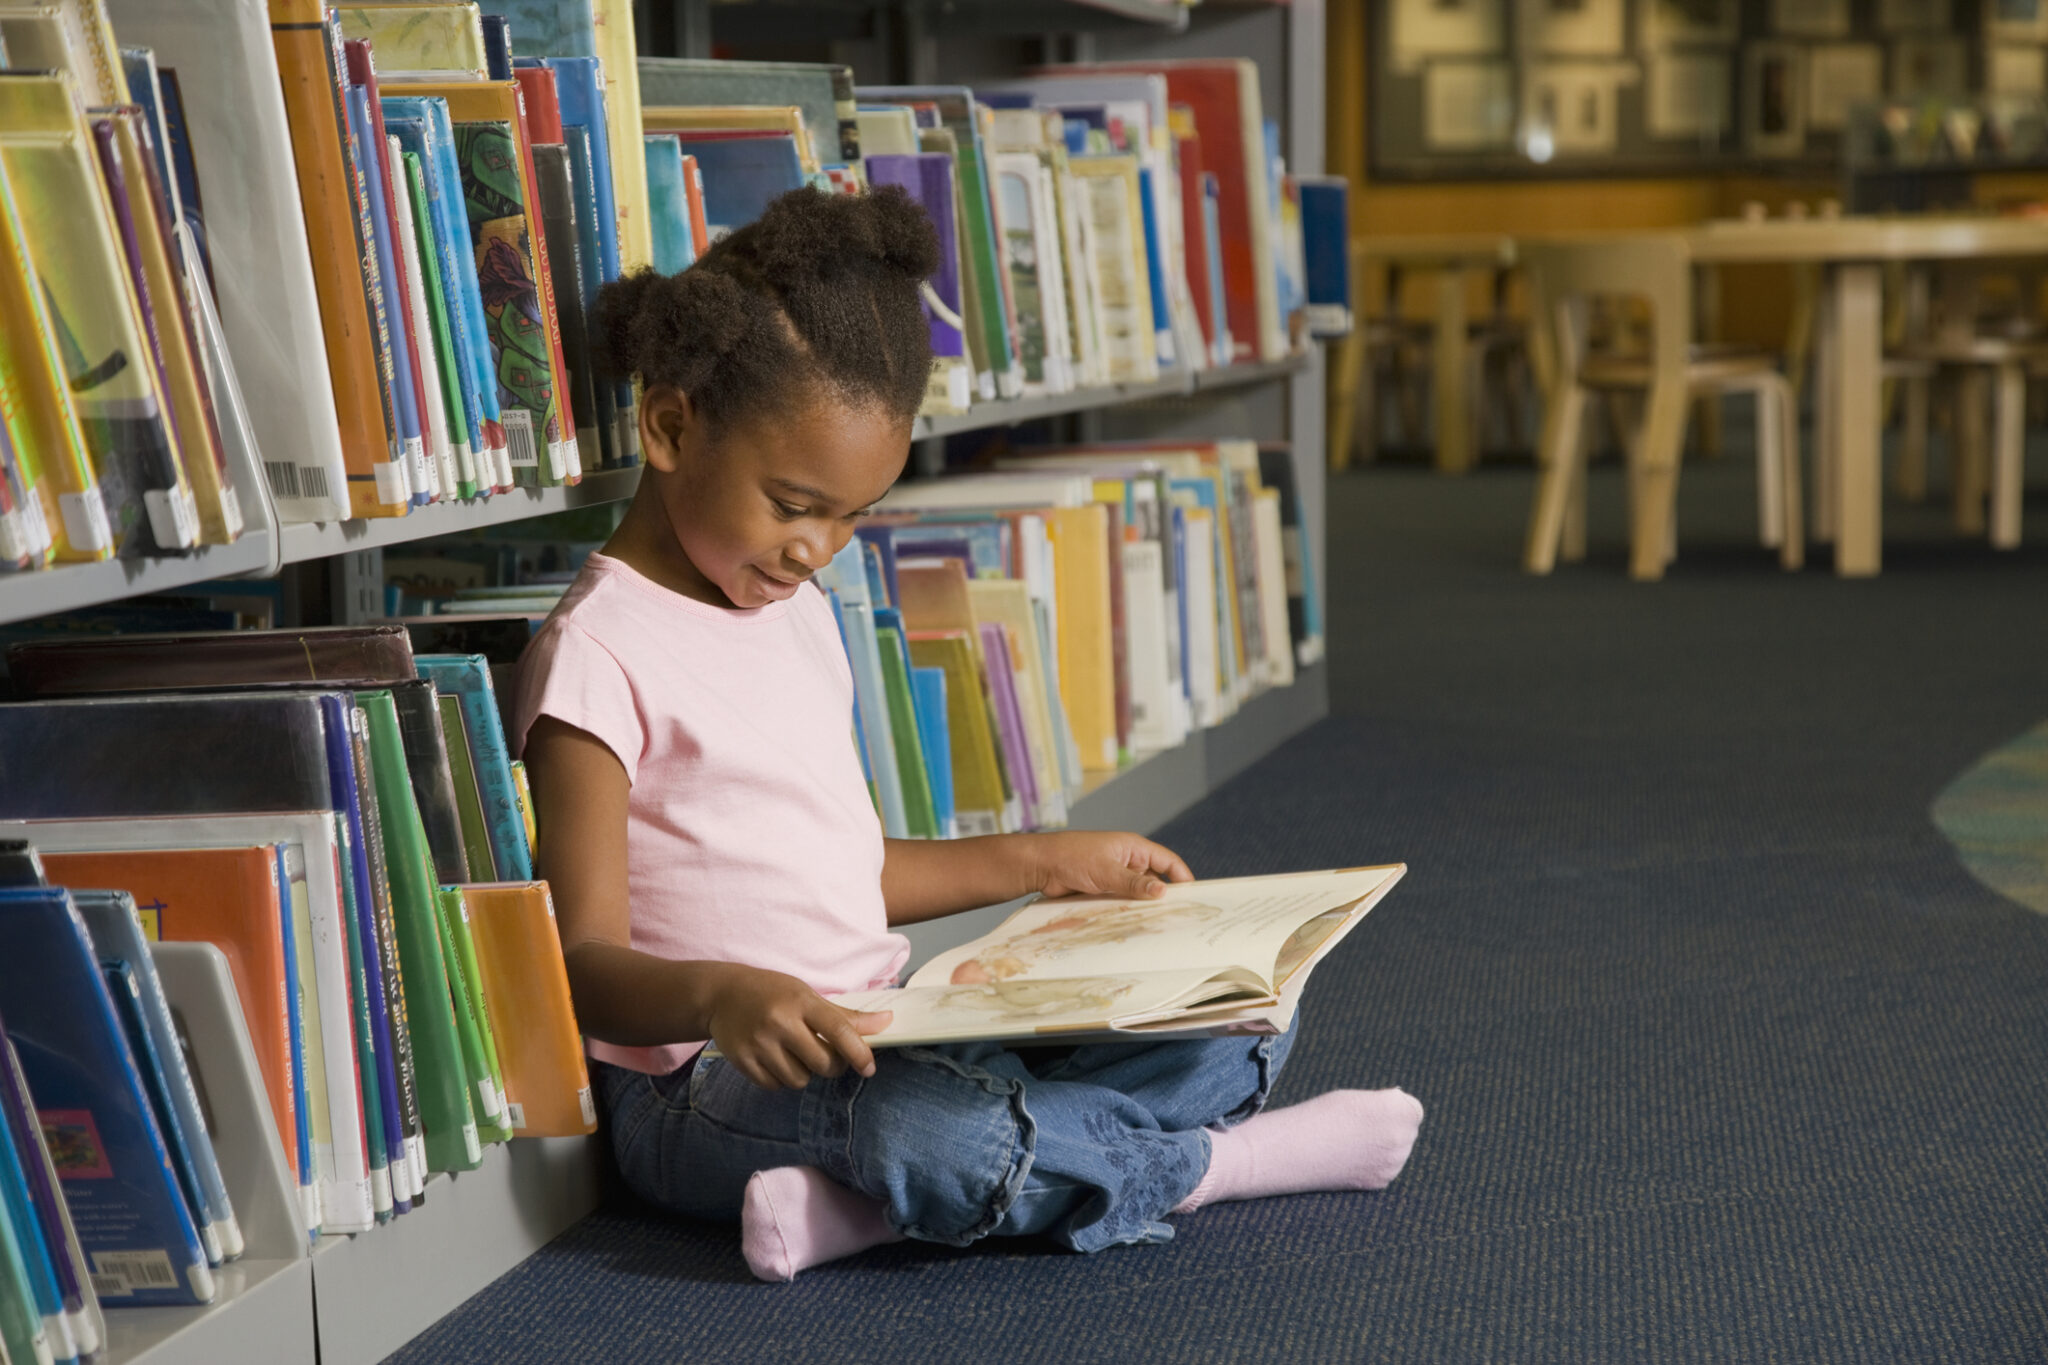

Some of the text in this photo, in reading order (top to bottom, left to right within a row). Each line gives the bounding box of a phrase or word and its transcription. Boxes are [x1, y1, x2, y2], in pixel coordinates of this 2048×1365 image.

[538, 235, 561, 344] YOU BAD DOG!
[383, 941, 393, 969] DAY
[393, 1004, 405, 1053] STONES
[400, 1062, 416, 1126] WALKED
